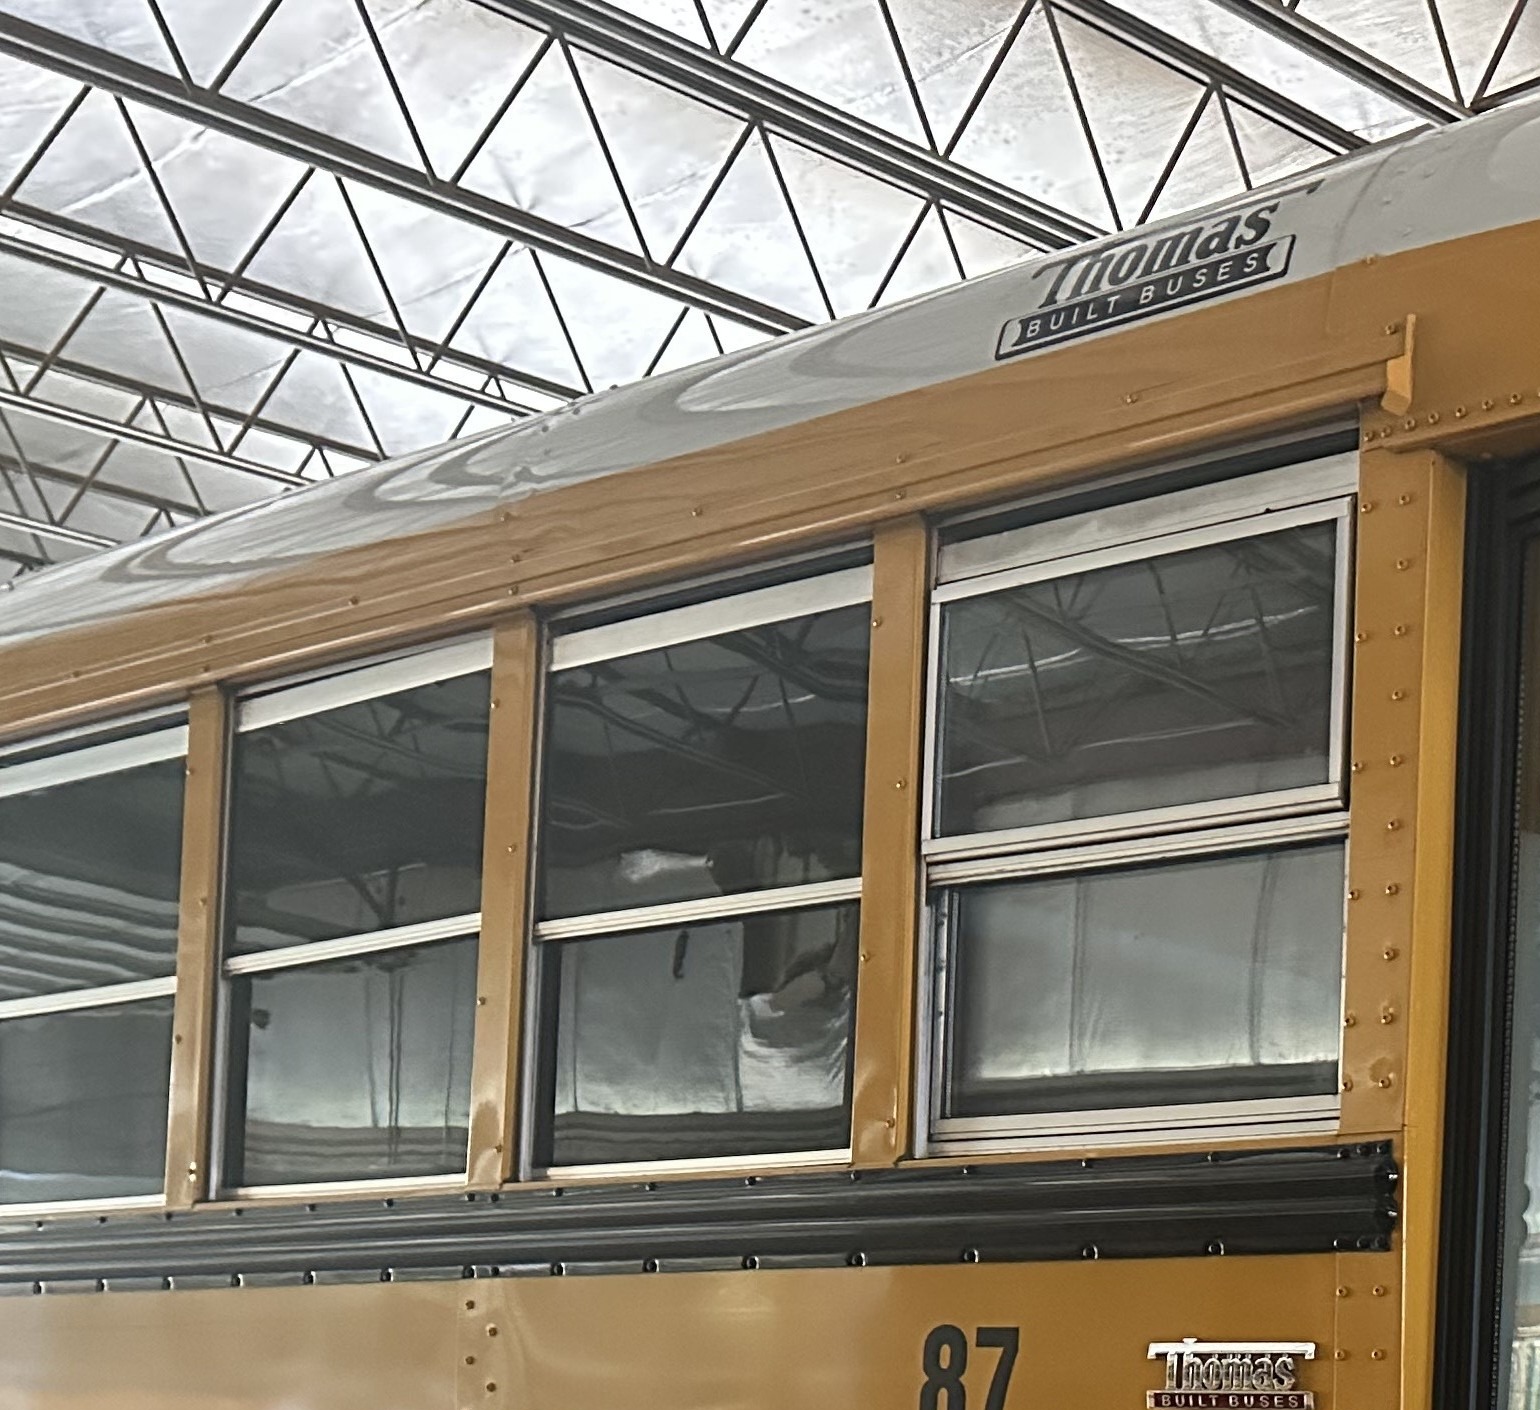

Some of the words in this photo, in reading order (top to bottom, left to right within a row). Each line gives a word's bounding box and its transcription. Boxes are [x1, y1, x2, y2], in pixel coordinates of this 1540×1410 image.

[1031, 178, 1325, 310] Thomas
[1026, 297, 1124, 339] BUILT
[1139, 252, 1260, 303] BUSES
[1147, 1337, 1316, 1391] Thomas
[1161, 1394, 1219, 1408] BUILT
[1229, 1394, 1299, 1408] BUSES
